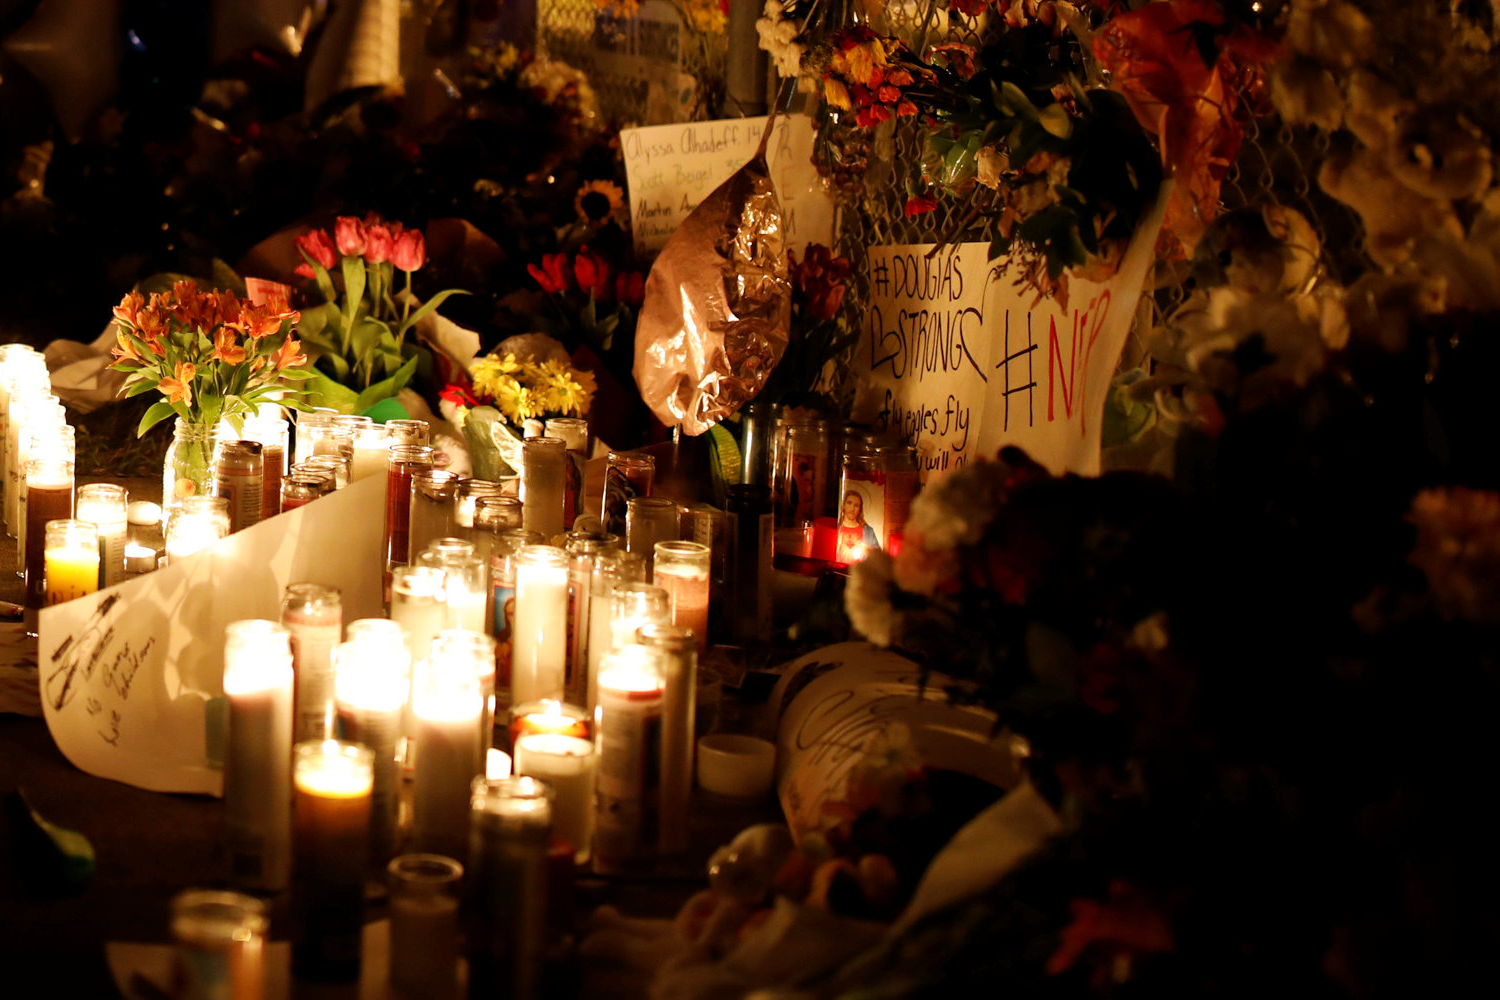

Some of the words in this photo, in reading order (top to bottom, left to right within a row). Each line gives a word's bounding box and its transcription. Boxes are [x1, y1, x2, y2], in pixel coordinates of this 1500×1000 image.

[627, 131, 675, 166] Alyssa
[636, 199, 672, 220] Martin
[891, 308, 963, 382] STRONG
[905, 403, 939, 448] eagles
[940, 394, 970, 452] fly
[925, 448, 949, 471] will
